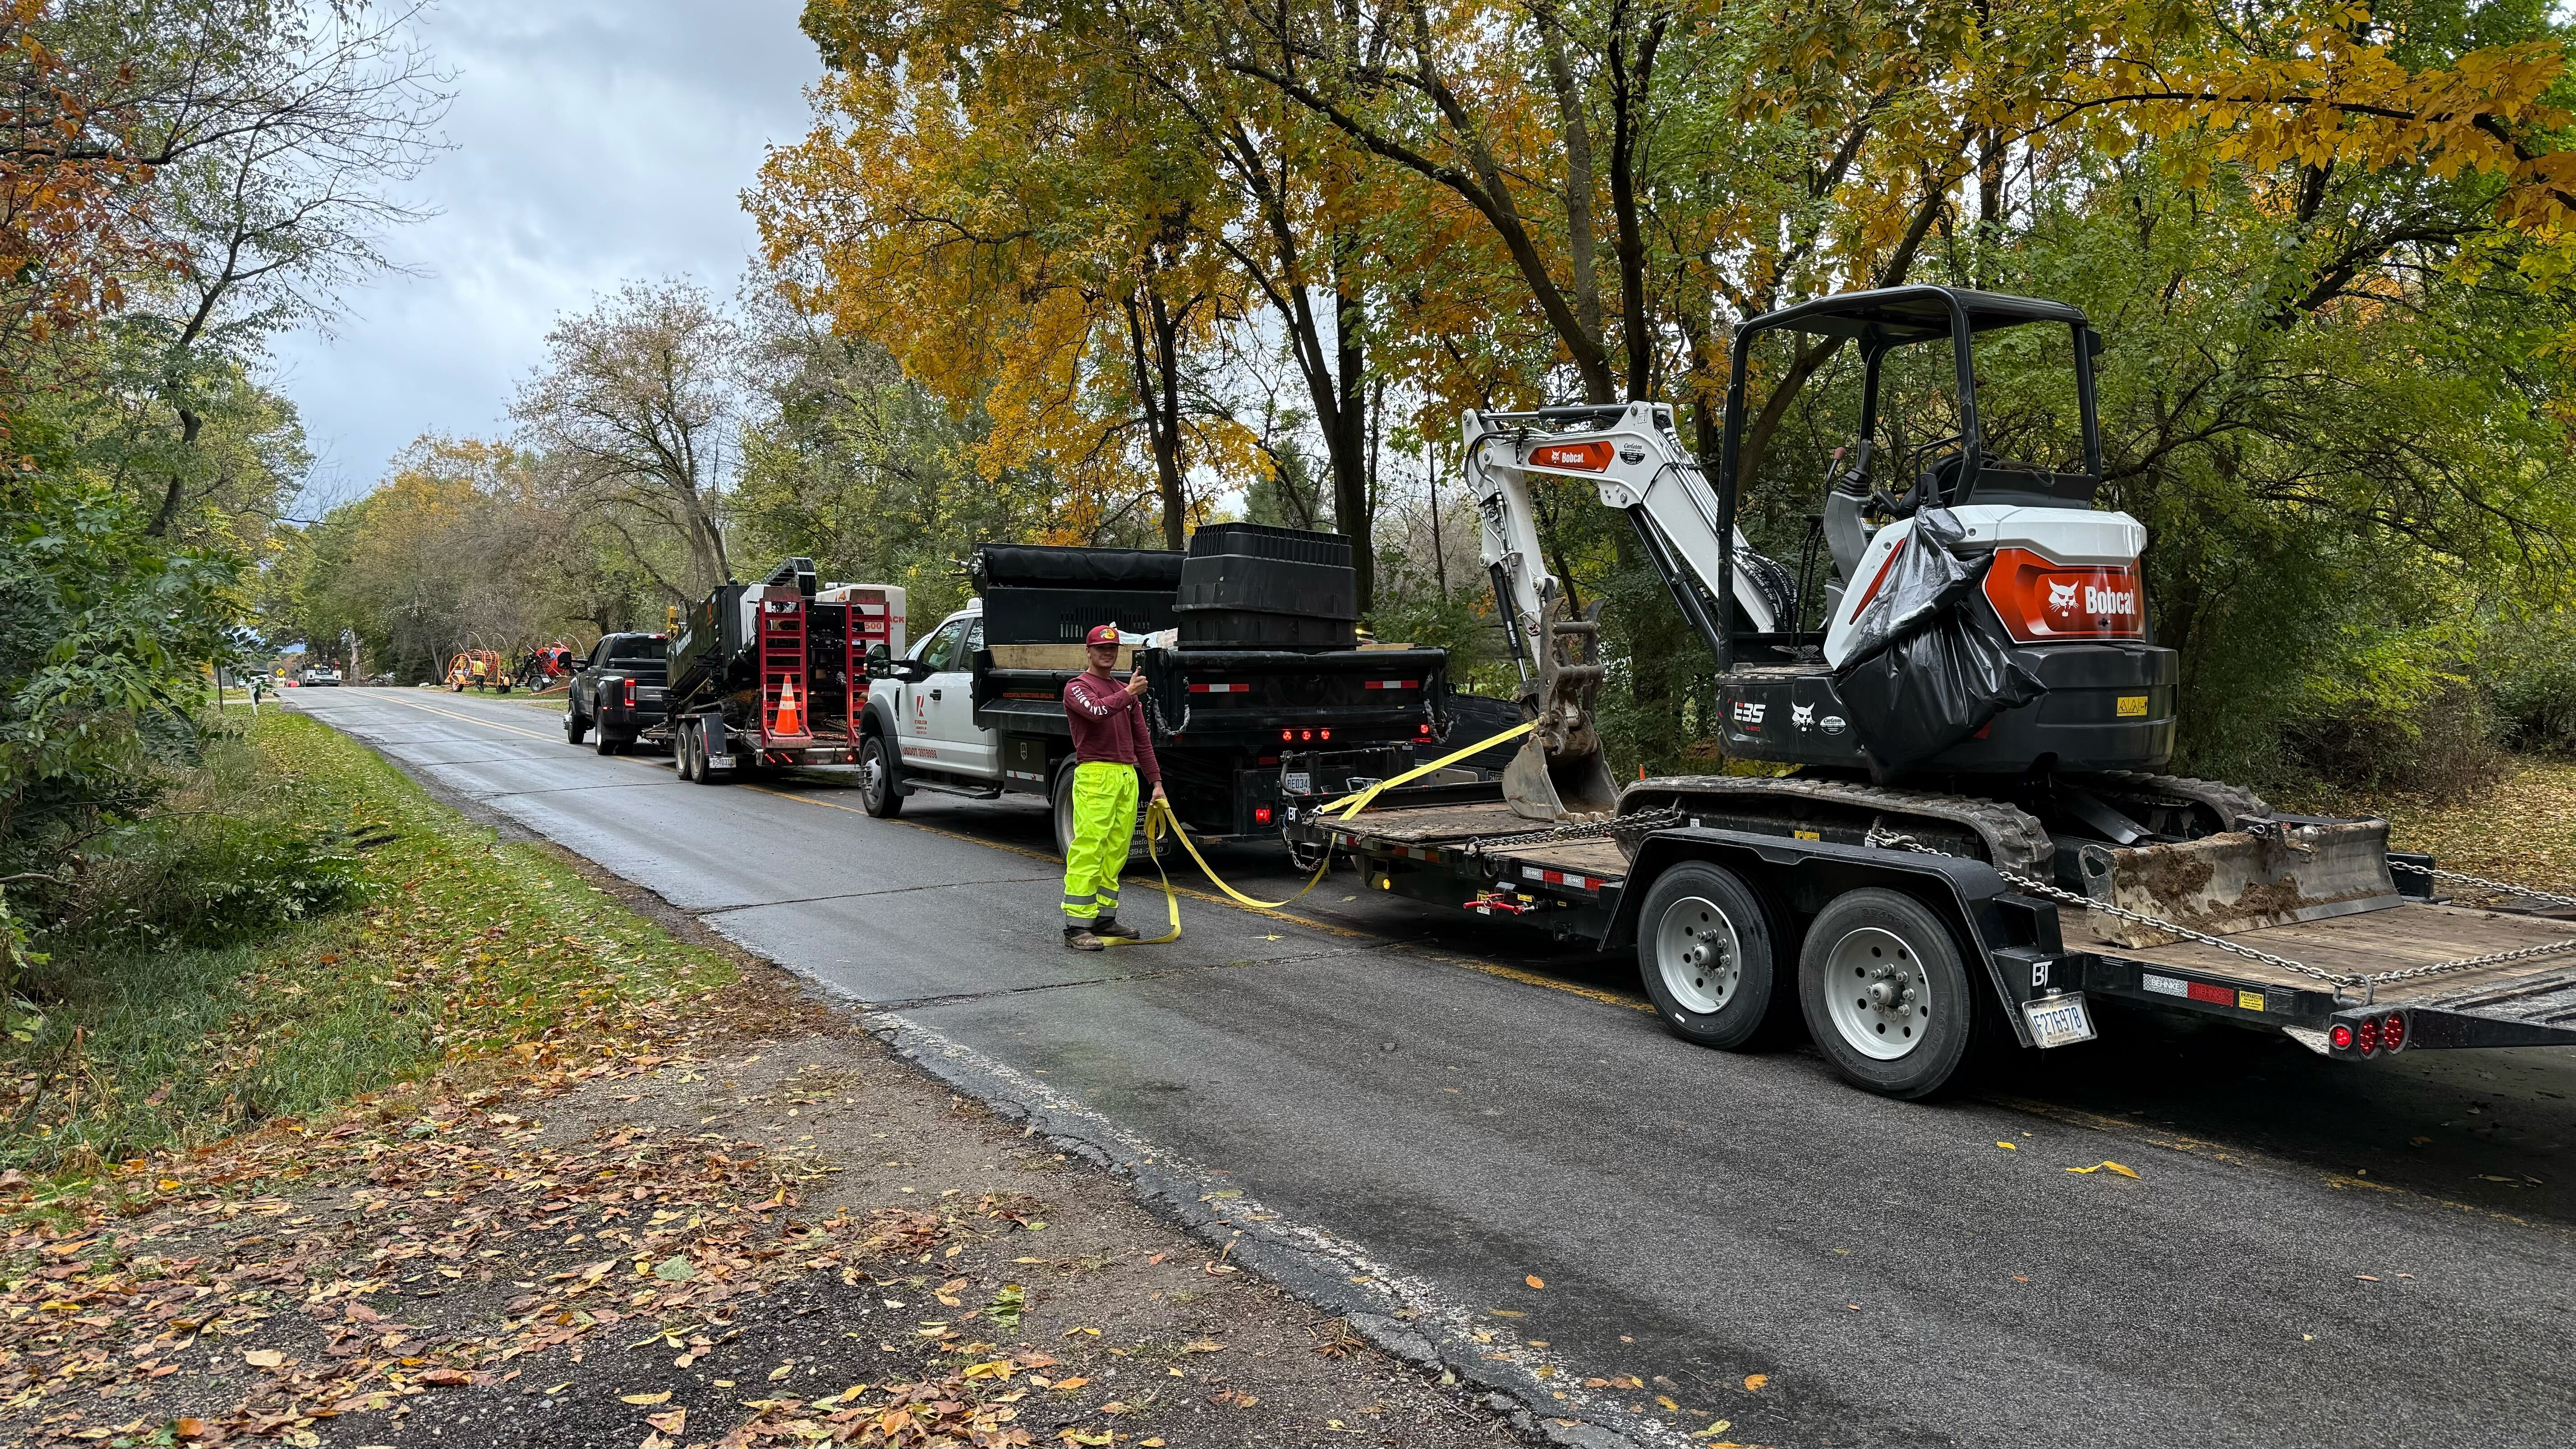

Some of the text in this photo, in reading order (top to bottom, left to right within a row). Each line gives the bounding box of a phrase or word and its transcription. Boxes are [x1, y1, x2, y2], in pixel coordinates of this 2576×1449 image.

[1562, 452, 1583, 463] Bobcat
[2085, 586, 2135, 615] Bobcat
[676, 628, 692, 656] Vermeer
[1089, 705, 1108, 715] STAY
[1734, 702, 1766, 723] E35
[1288, 778, 1311, 789] RE034
[1288, 807, 1297, 823] BT
[2033, 961, 2053, 988] BT
[2151, 979, 2180, 991] BEHNKE
[2195, 987, 2226, 999] BEHNKE
[2033, 1007, 2082, 1037] F276978
